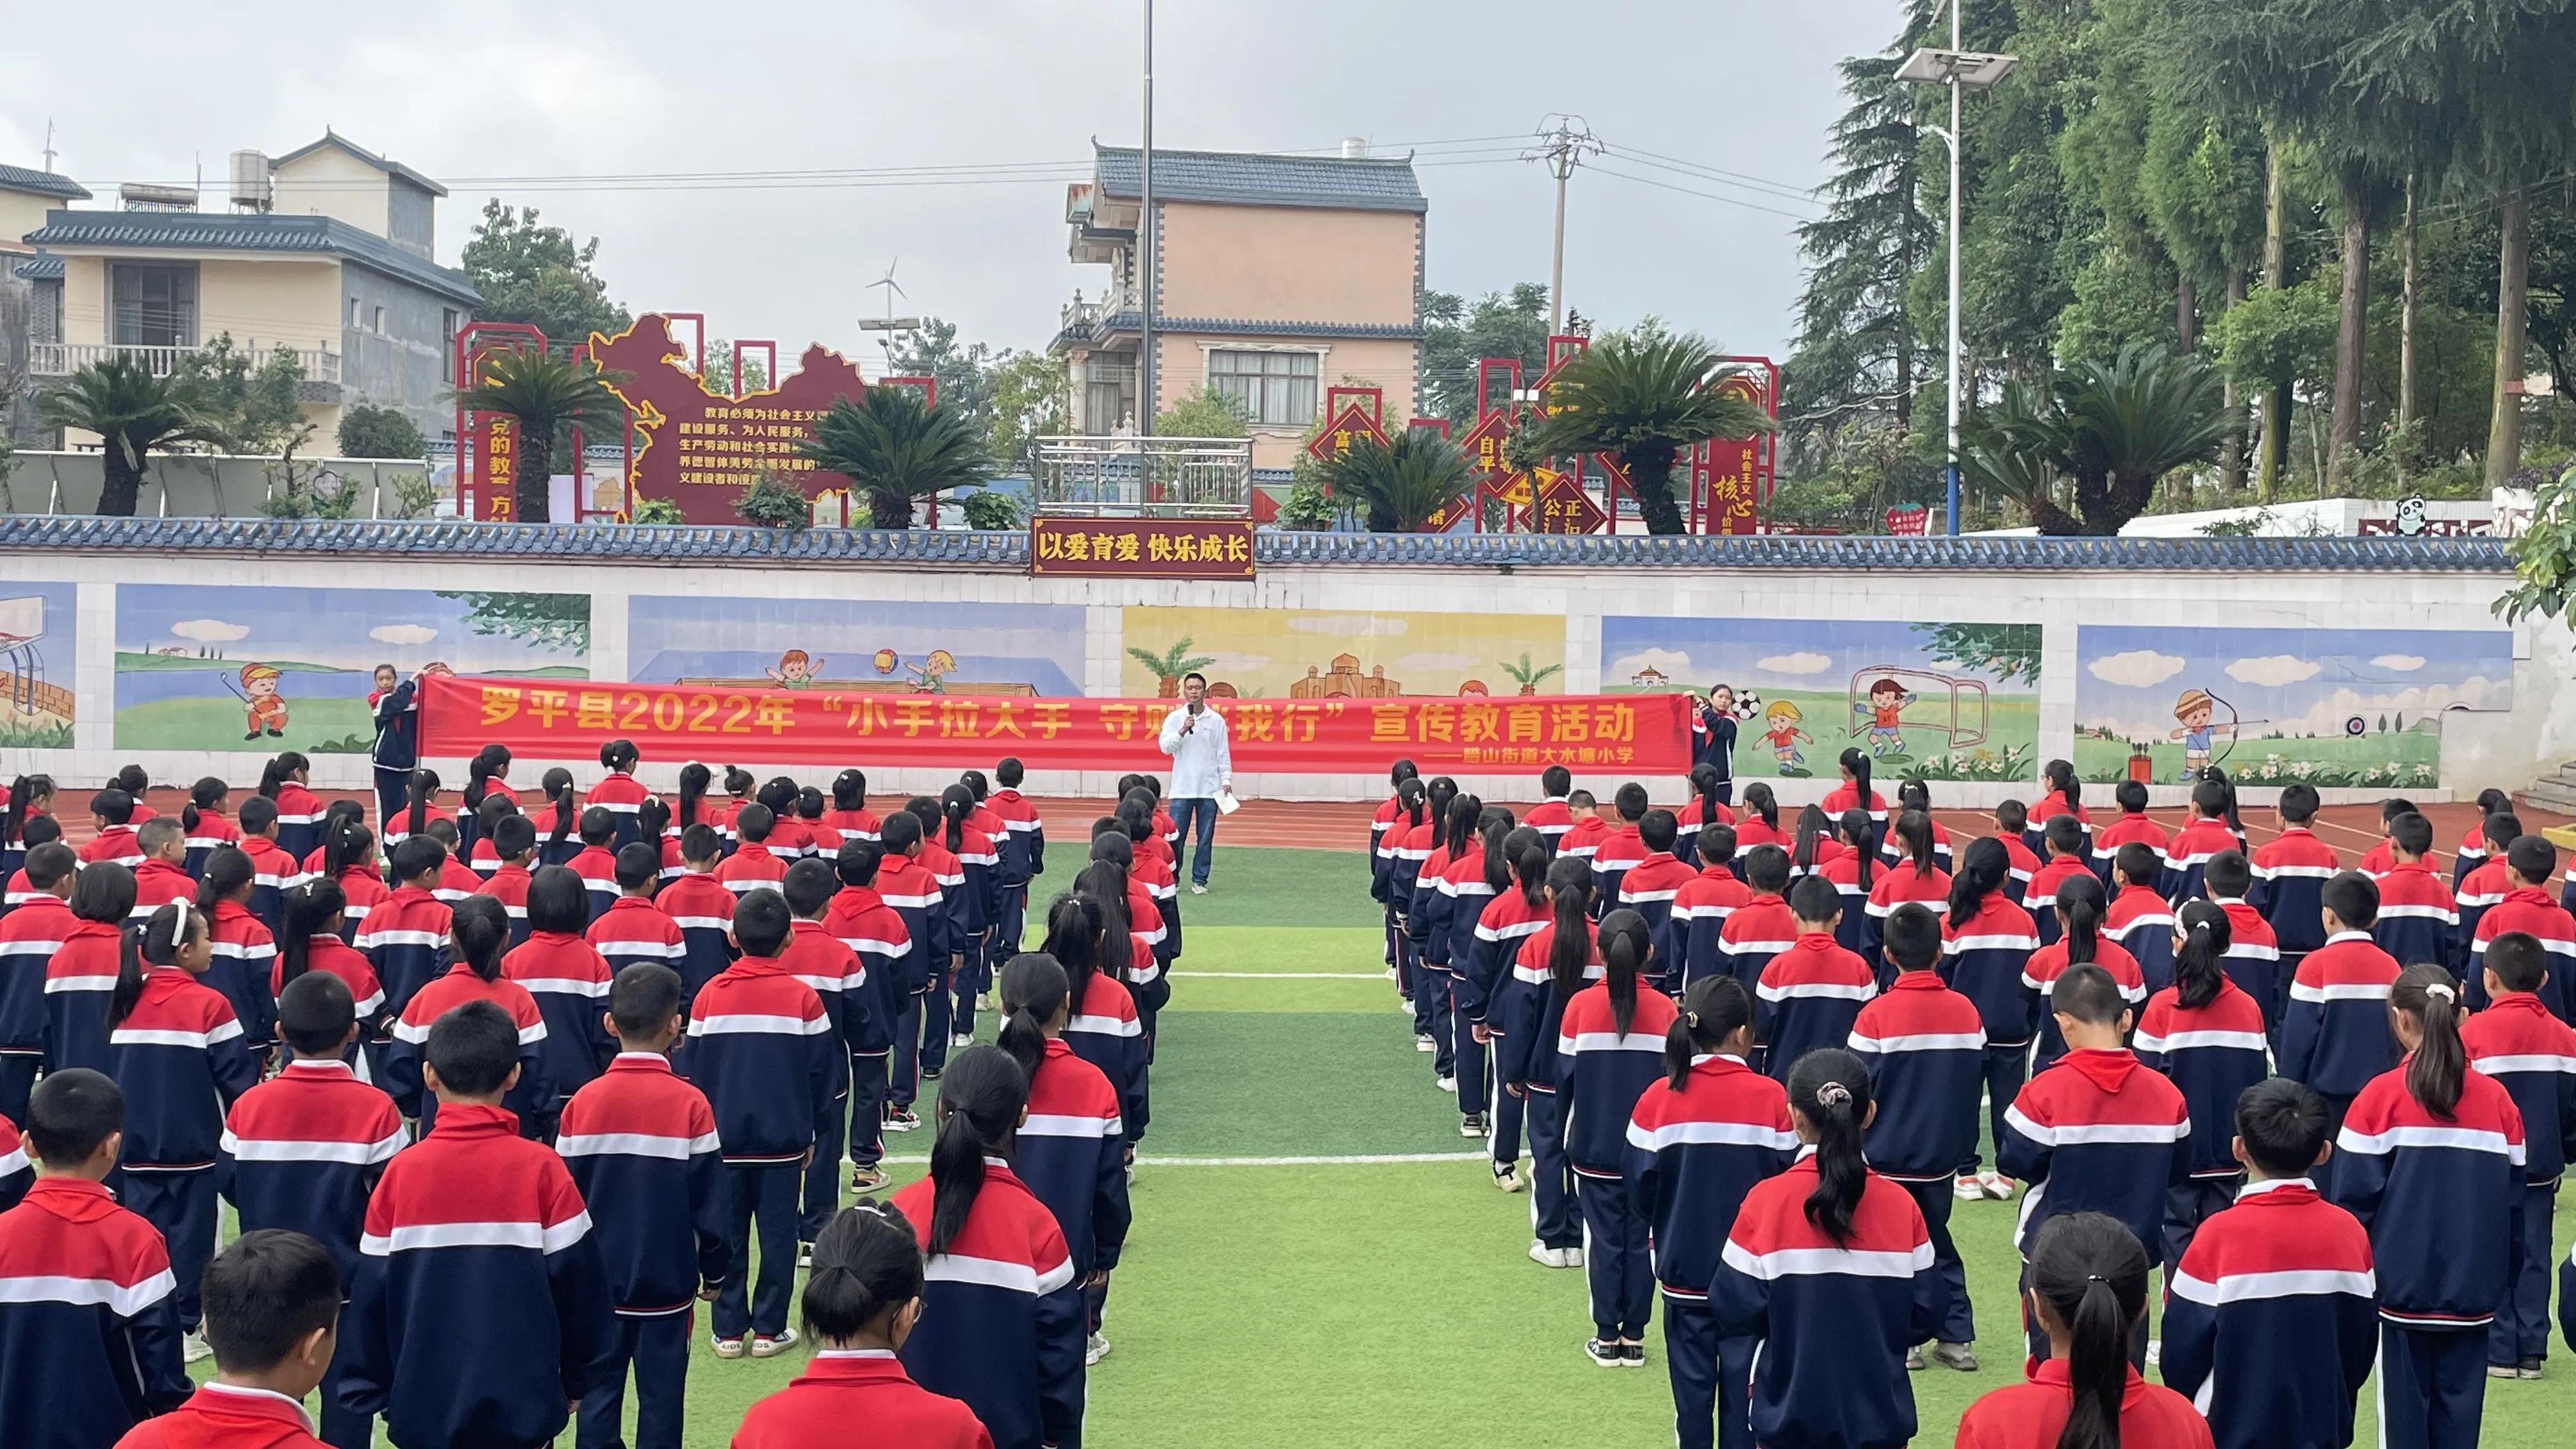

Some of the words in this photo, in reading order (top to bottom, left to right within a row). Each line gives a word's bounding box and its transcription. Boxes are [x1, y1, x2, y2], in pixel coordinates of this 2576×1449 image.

[705, 407, 834, 422] 教育必须为社会主义现
[679, 456, 820, 471] 养德智体美劳全面发展的
[1741, 449, 1752, 495] 社会主义
[1544, 498, 1582, 517] 公正
[1713, 475, 1753, 518] 核心
[1039, 532, 1140, 562] 以爱育爱
[1147, 533, 1249, 563] 快乐成长
[480, 686, 795, 735] 罗平县2022年
[1370, 703, 1635, 743] 宣传教育活动
